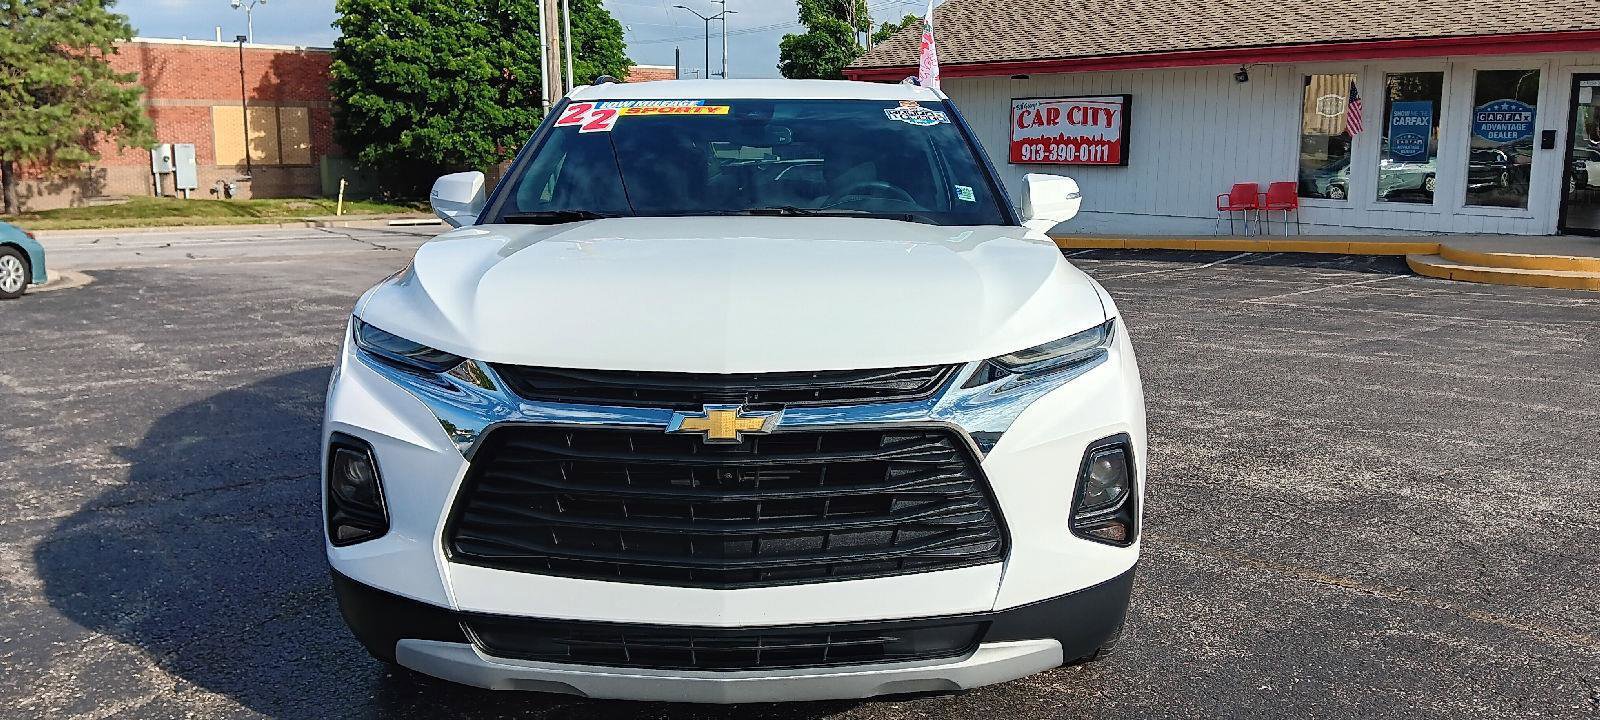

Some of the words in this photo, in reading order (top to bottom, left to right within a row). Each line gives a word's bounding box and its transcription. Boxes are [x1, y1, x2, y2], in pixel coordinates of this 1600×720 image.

[625, 107, 720, 115] SPORTY
[1018, 107, 1061, 128] CAR
[1067, 106, 1117, 128] CITY
[1393, 117, 1429, 125] CARFAX
[1022, 144, 1108, 161] 913-390-0111
